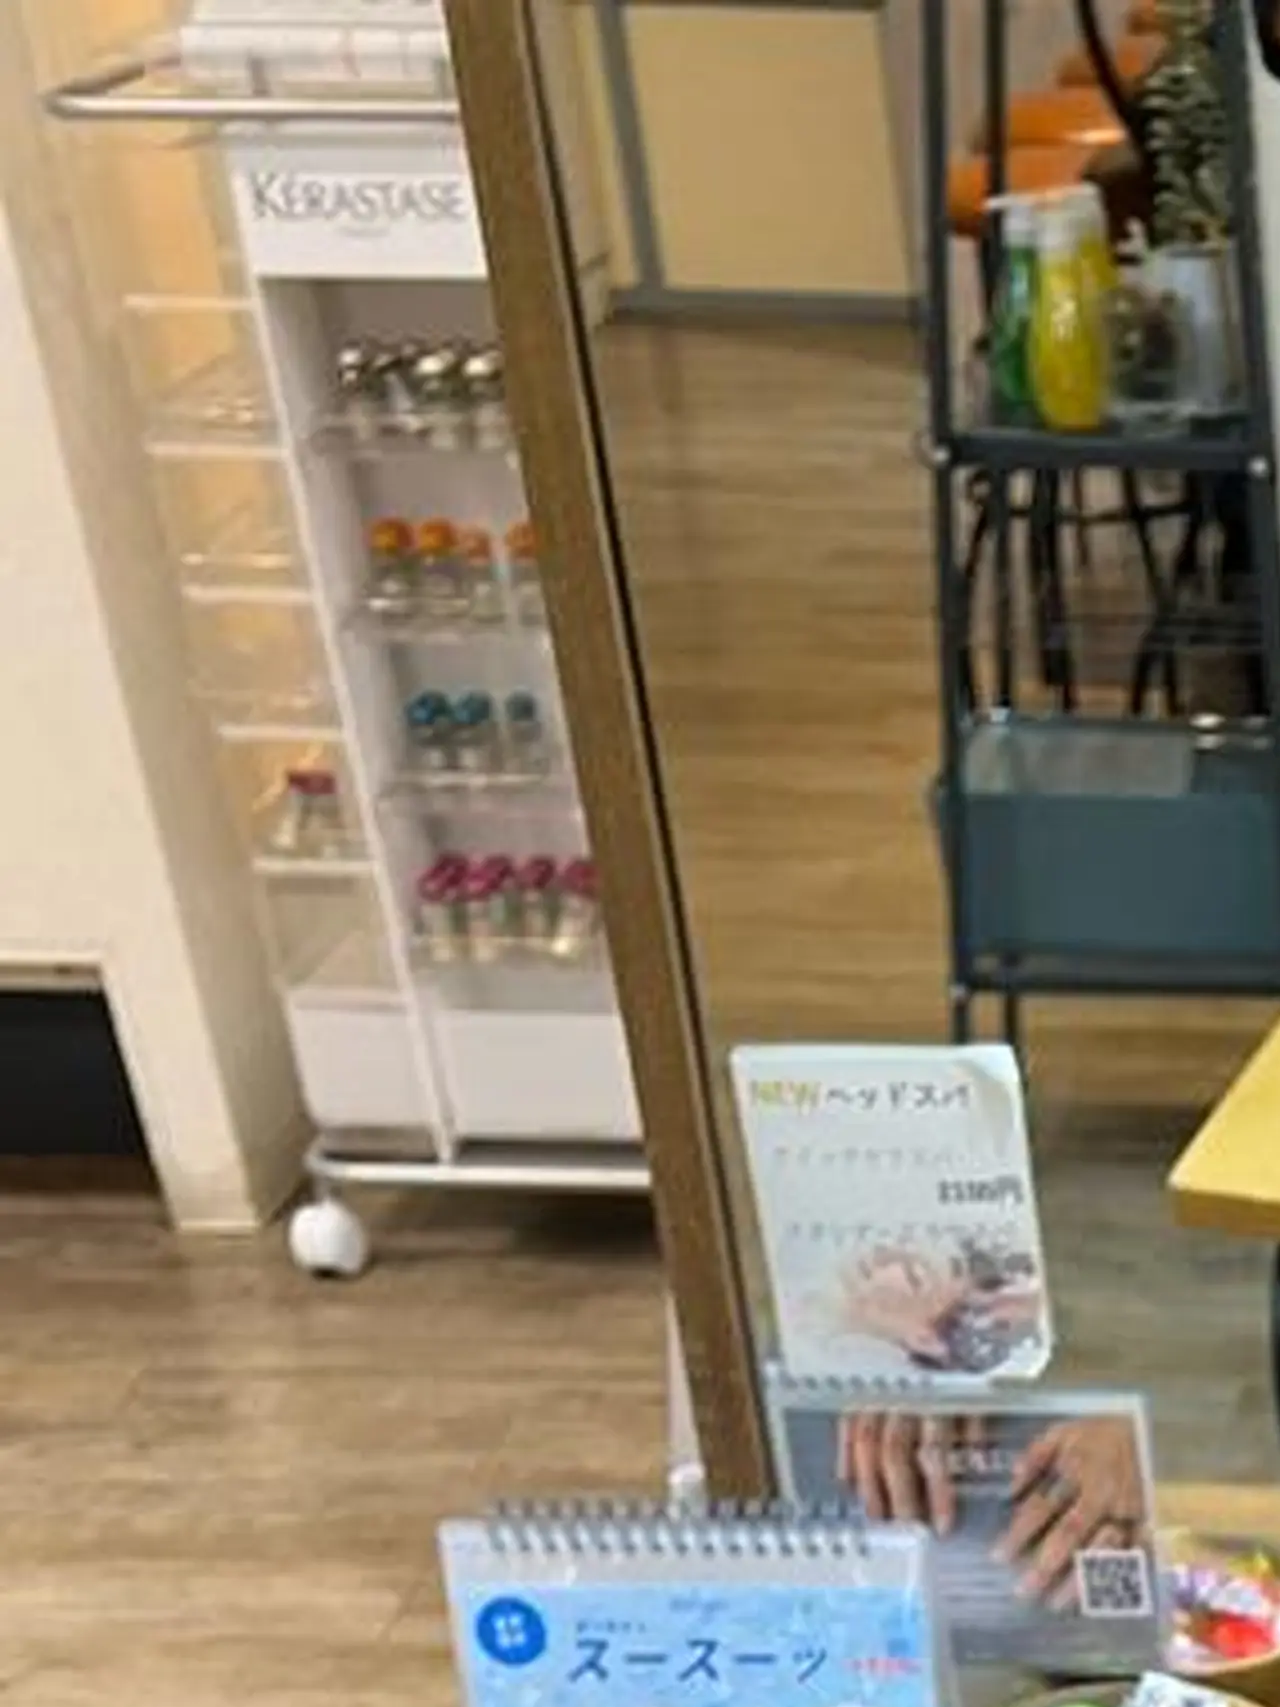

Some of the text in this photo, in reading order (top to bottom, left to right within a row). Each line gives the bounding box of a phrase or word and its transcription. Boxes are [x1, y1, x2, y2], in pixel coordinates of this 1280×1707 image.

[567, 1638, 828, 1684] スースーッ
